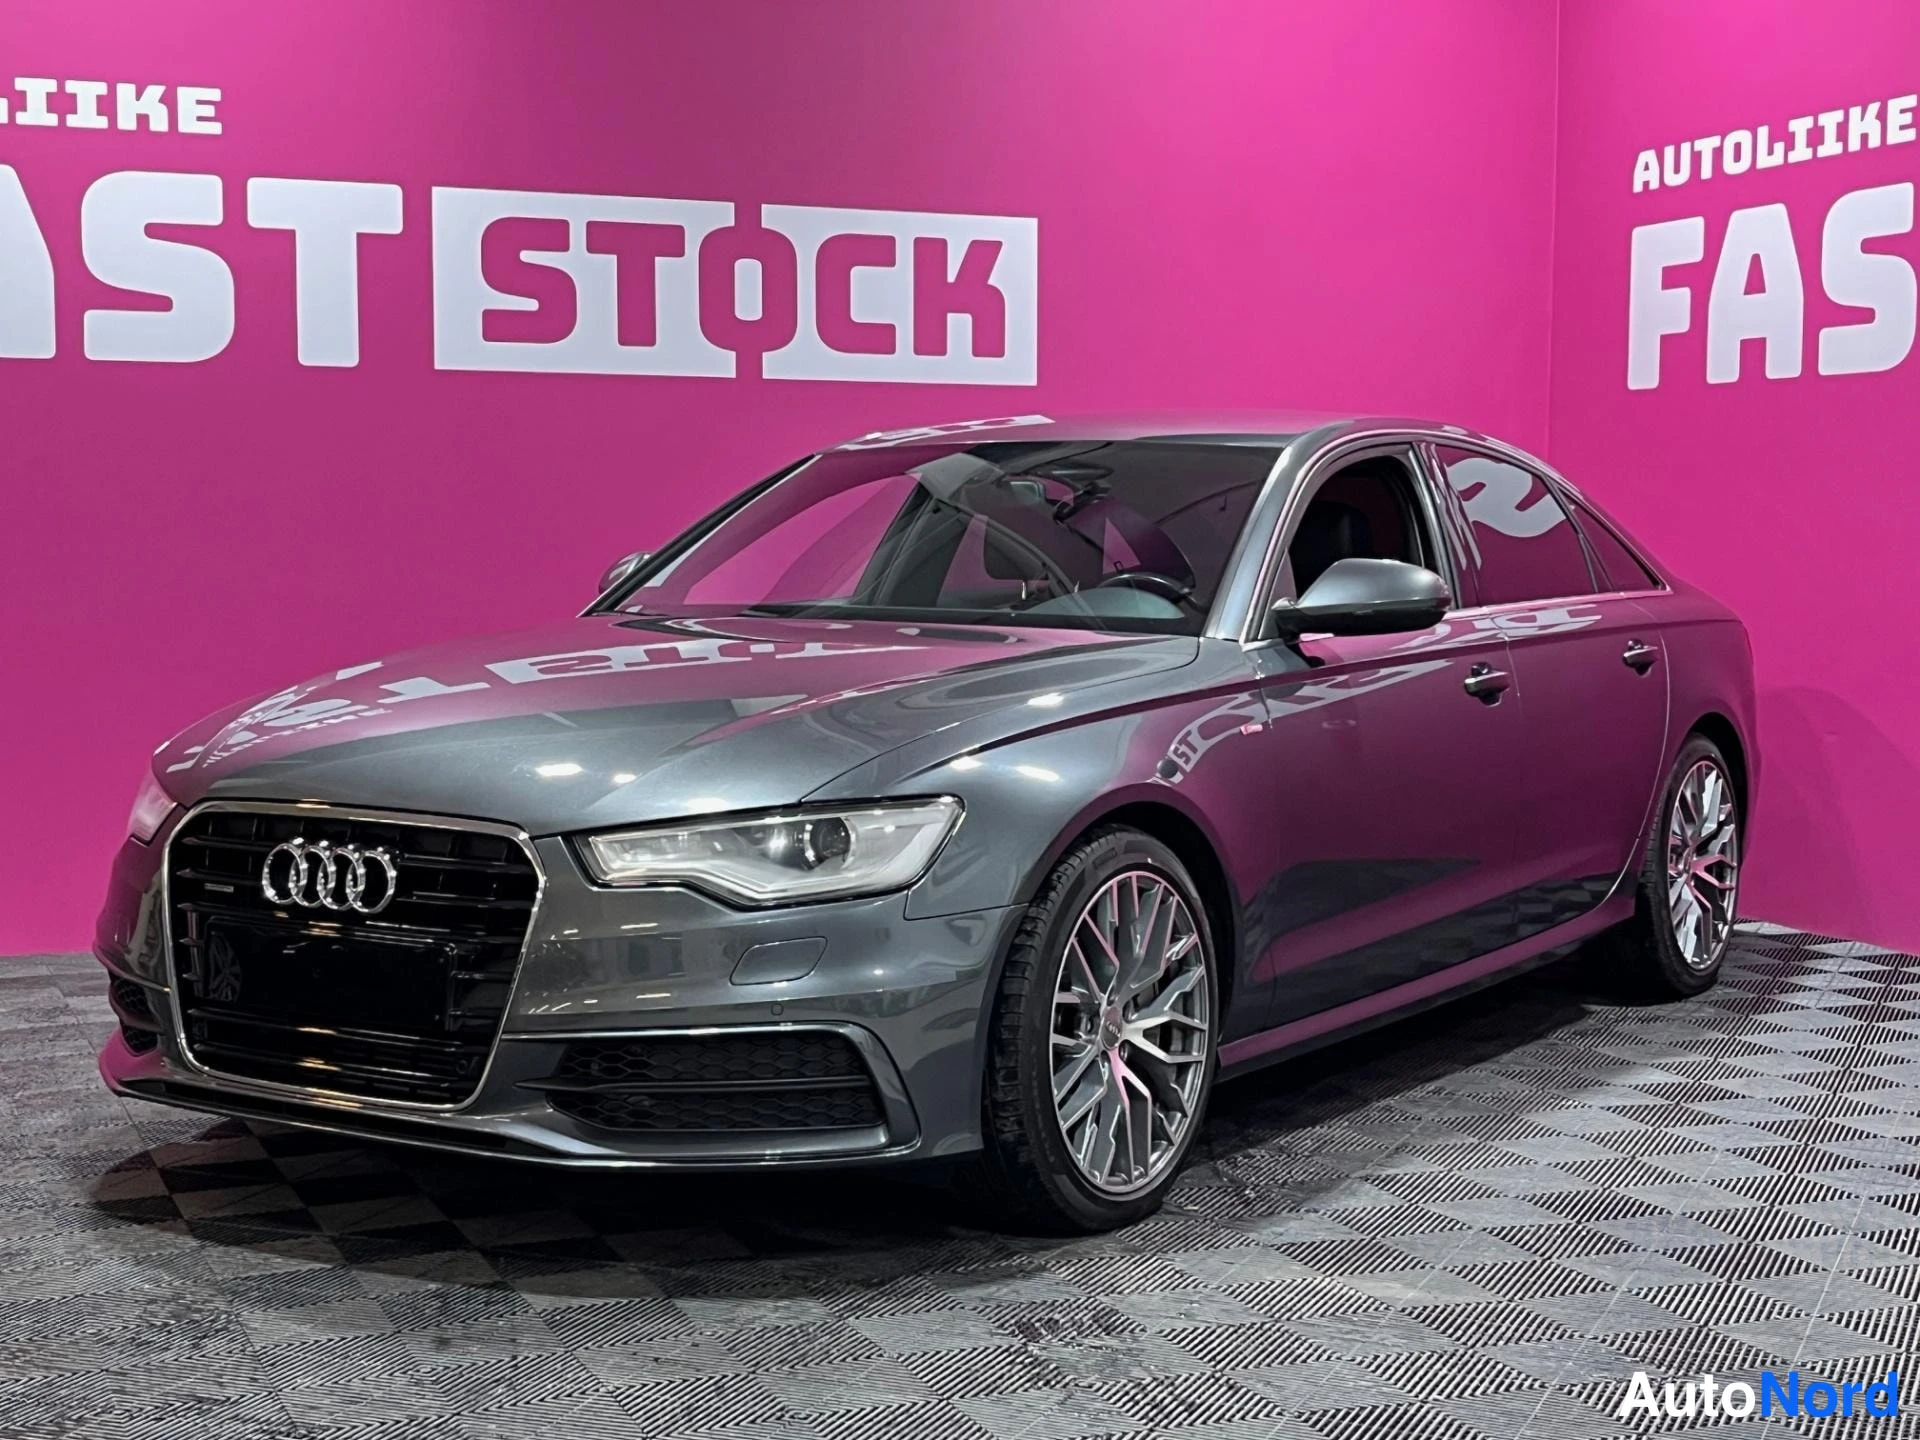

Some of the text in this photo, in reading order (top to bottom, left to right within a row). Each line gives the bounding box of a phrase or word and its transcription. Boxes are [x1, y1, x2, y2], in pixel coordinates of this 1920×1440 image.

[0, 77, 222, 135] IIKE
[1633, 94, 1918, 193] AUTOLIIKE
[481, 216, 1005, 358] STOCK
[1627, 182, 1918, 390] FAS
